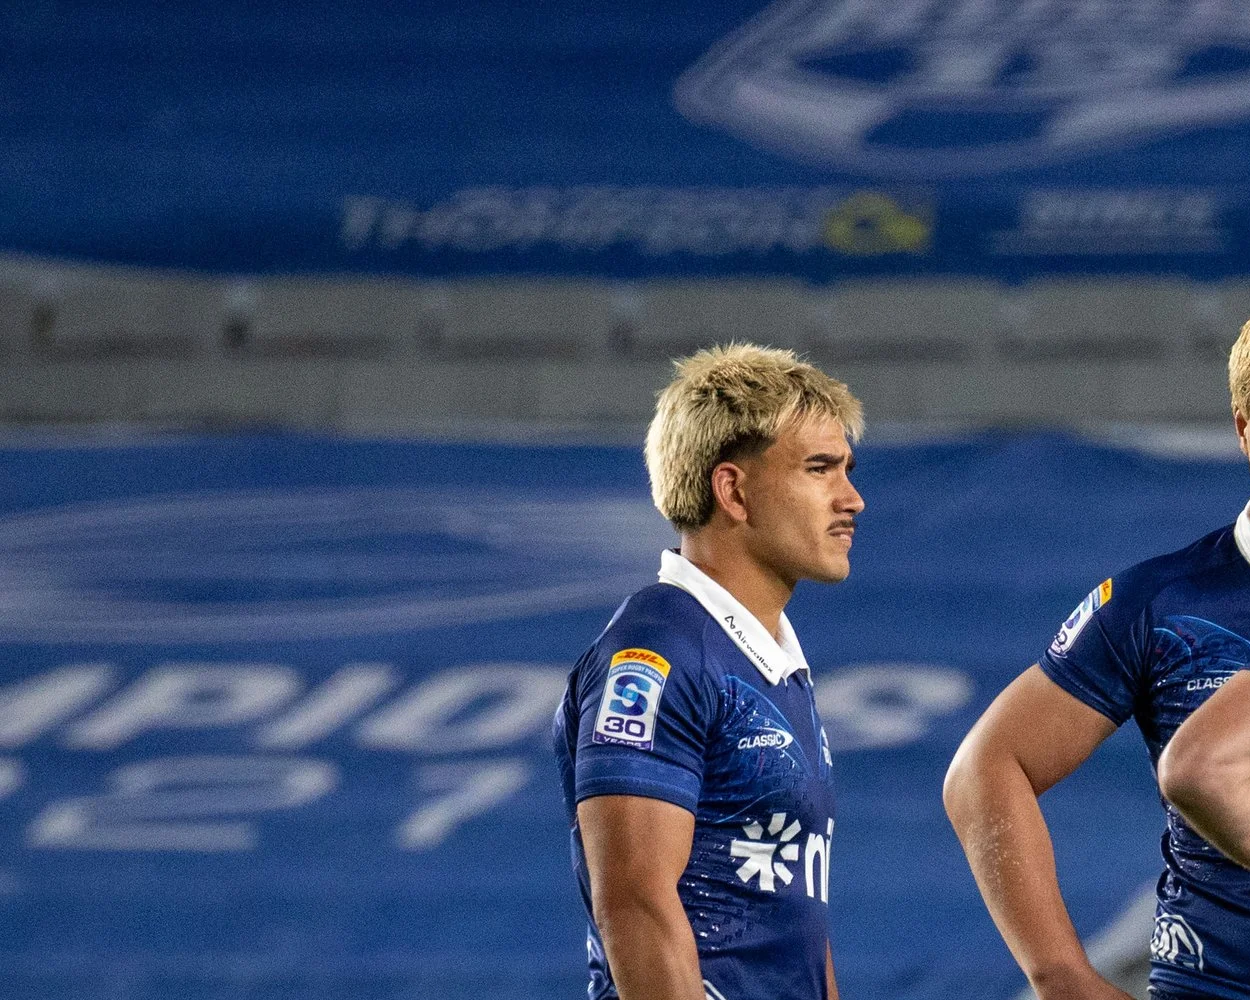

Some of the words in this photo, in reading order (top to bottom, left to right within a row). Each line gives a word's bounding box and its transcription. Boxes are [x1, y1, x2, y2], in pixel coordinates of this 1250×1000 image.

[622, 651, 660, 664] DHL
[735, 630, 774, 673] Airwallex
[603, 716, 646, 739] 30
[737, 734, 783, 750] CLASSIC
